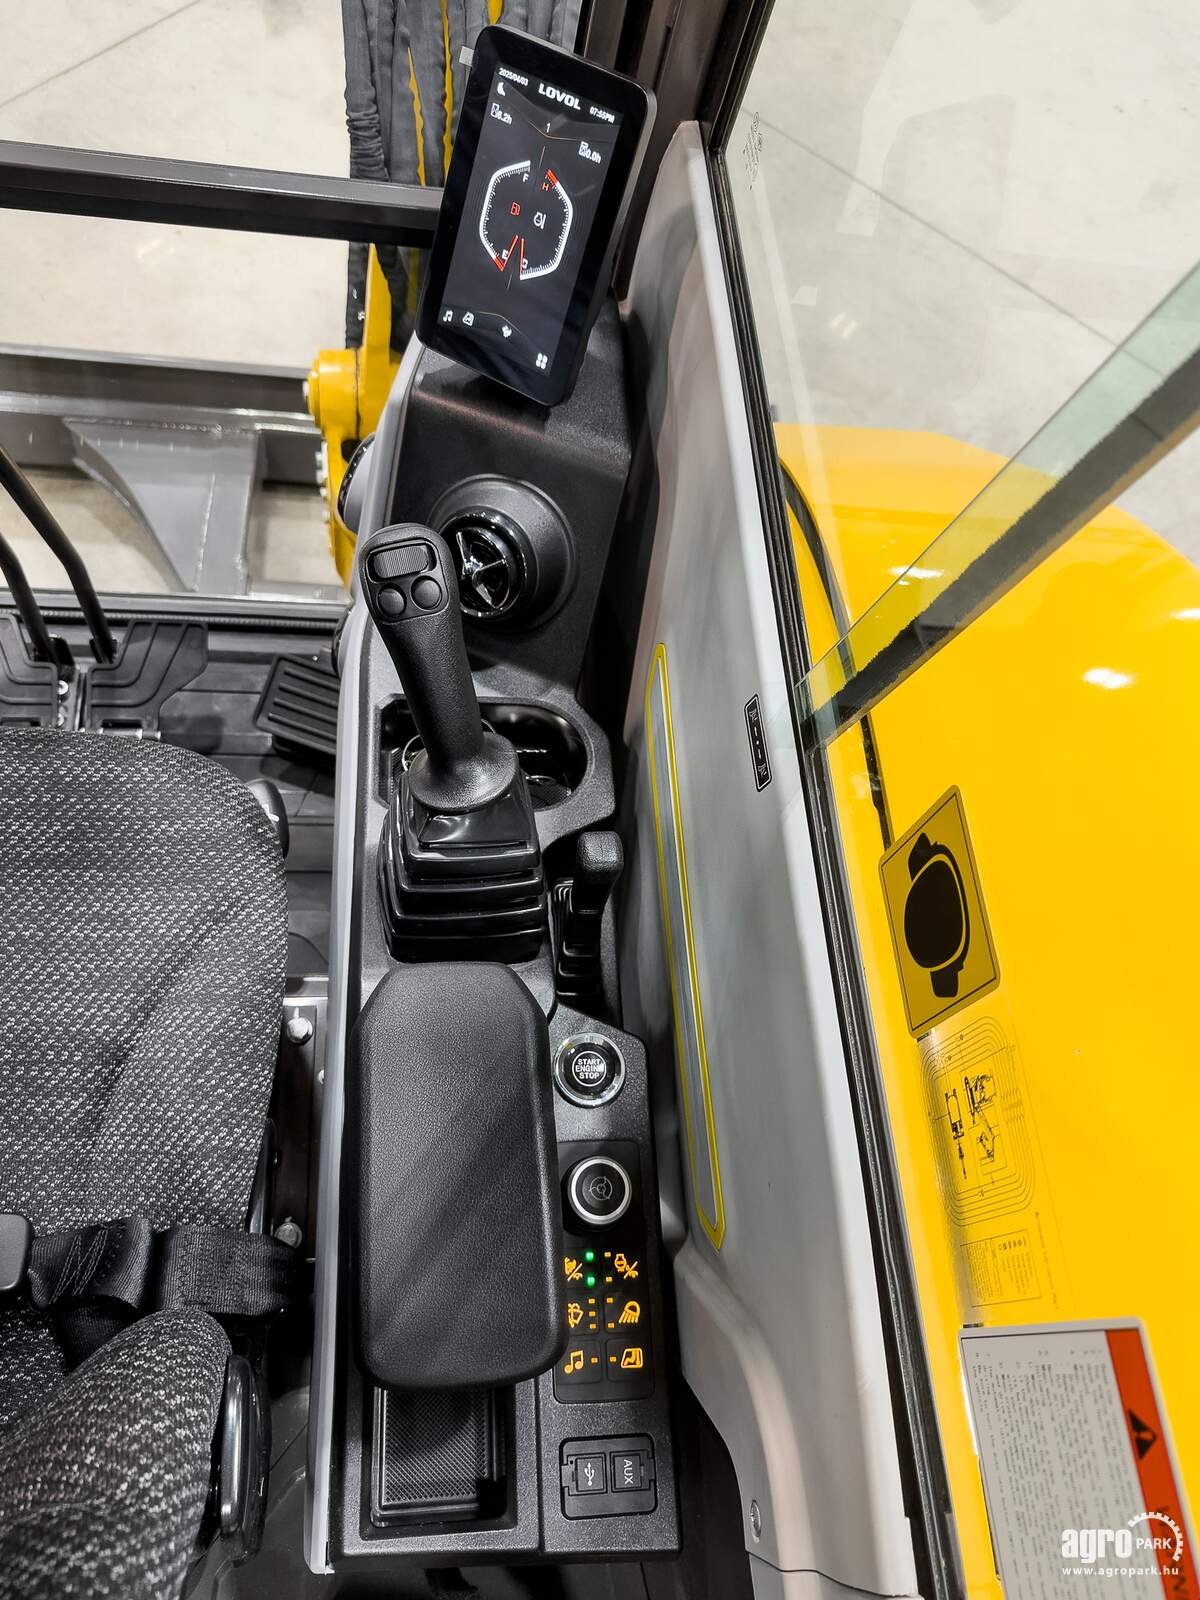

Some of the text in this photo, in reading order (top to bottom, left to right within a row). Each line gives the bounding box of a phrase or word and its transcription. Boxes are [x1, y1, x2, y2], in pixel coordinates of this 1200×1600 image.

[538, 83, 581, 110] LOVOL
[522, 173, 529, 182] F
[542, 182, 549, 191] H
[623, 1459, 634, 1485] AUX
